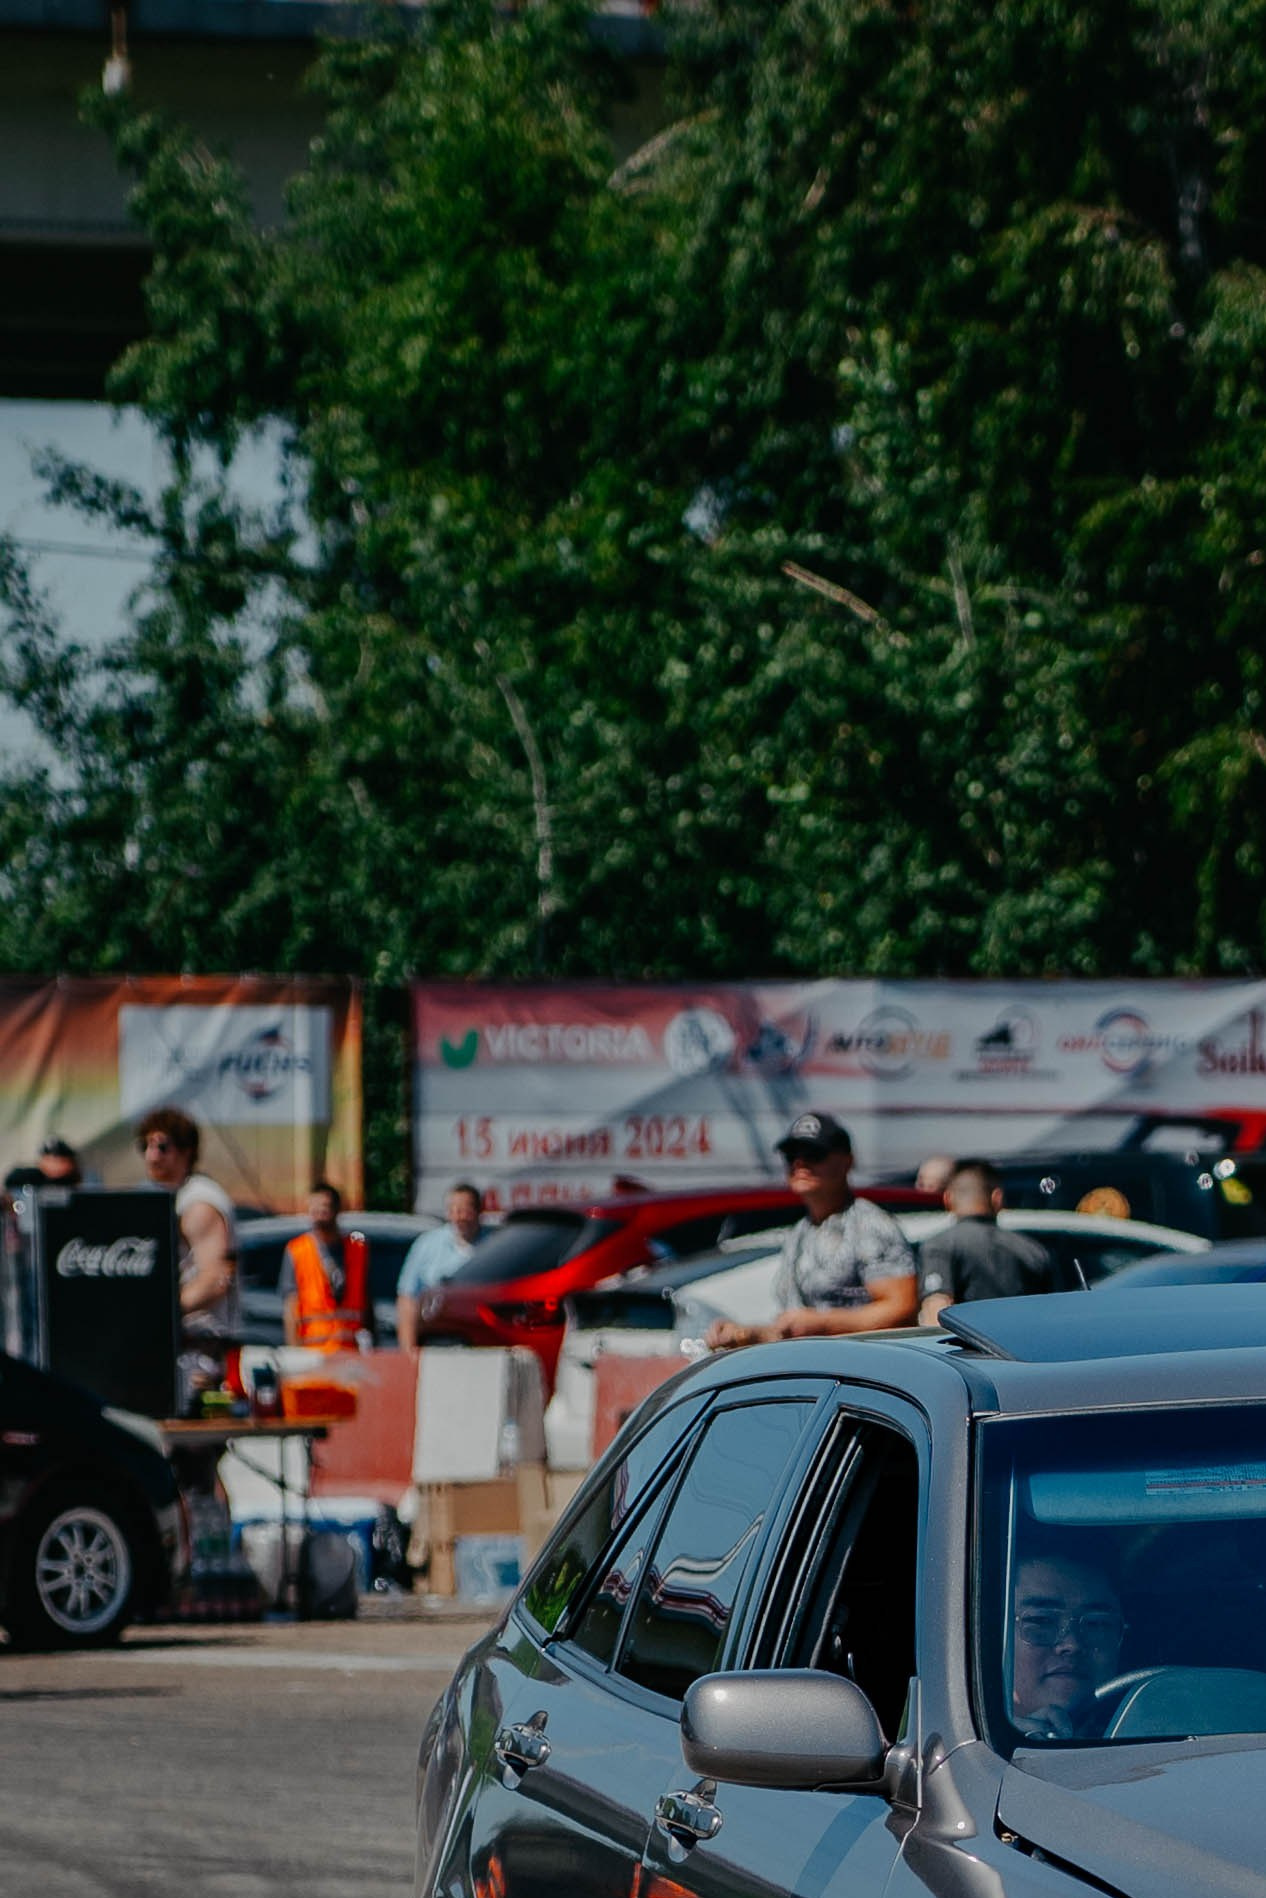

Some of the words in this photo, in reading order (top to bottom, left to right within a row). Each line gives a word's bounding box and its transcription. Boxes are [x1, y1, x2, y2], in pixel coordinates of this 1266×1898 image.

[486, 1024, 651, 1060] VICTORIA
[455, 1116, 494, 1158] 15
[508, 1128, 611, 1161] июня
[624, 1115, 713, 1158] 2024
